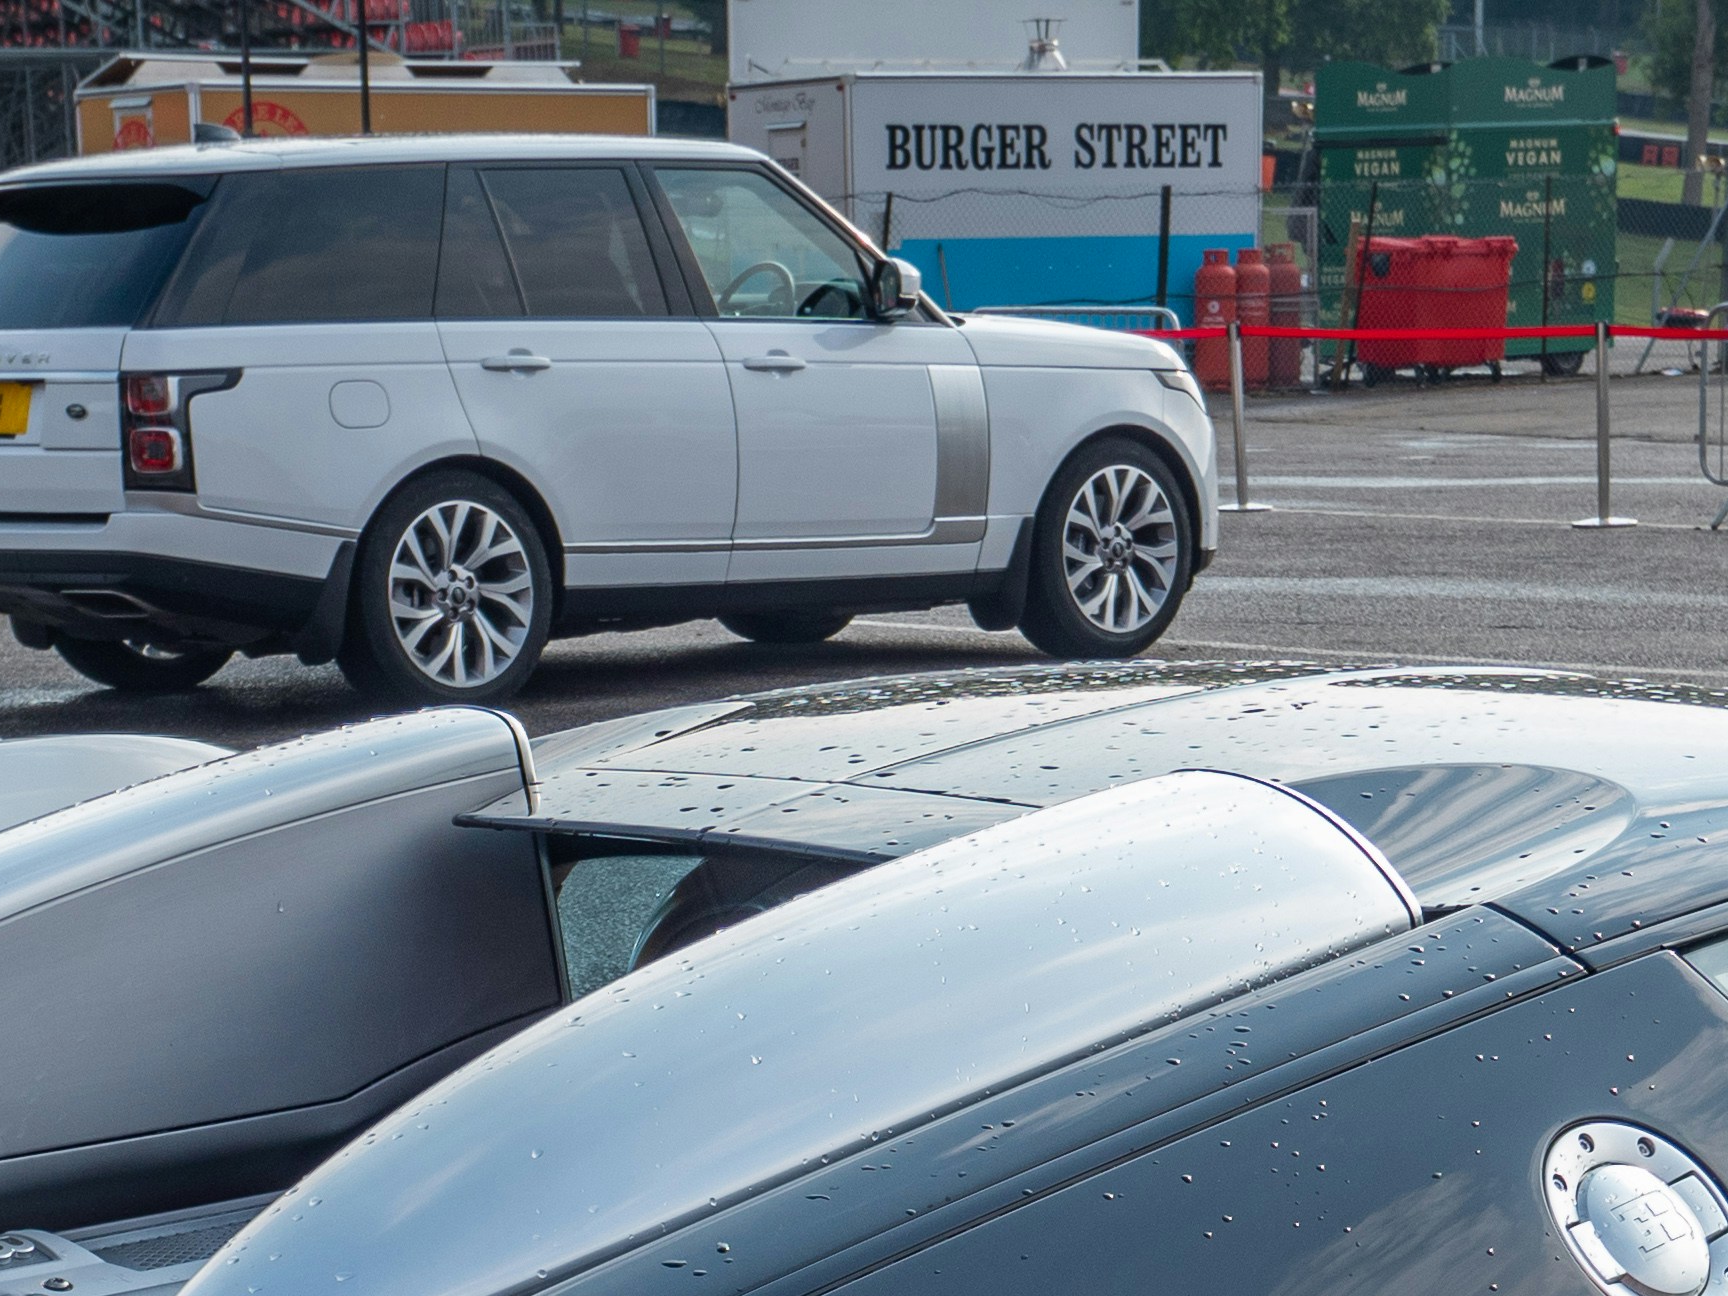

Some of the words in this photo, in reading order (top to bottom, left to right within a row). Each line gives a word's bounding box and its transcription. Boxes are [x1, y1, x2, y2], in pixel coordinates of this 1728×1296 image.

[1357, 89, 1407, 107] MAGNUM
[1504, 85, 1564, 103] MAGNUM
[885, 123, 1052, 171] BURGER
[1074, 122, 1228, 170] STREET
[1505, 151, 1562, 166] VEGAN
[1354, 161, 1401, 177] VEGAN
